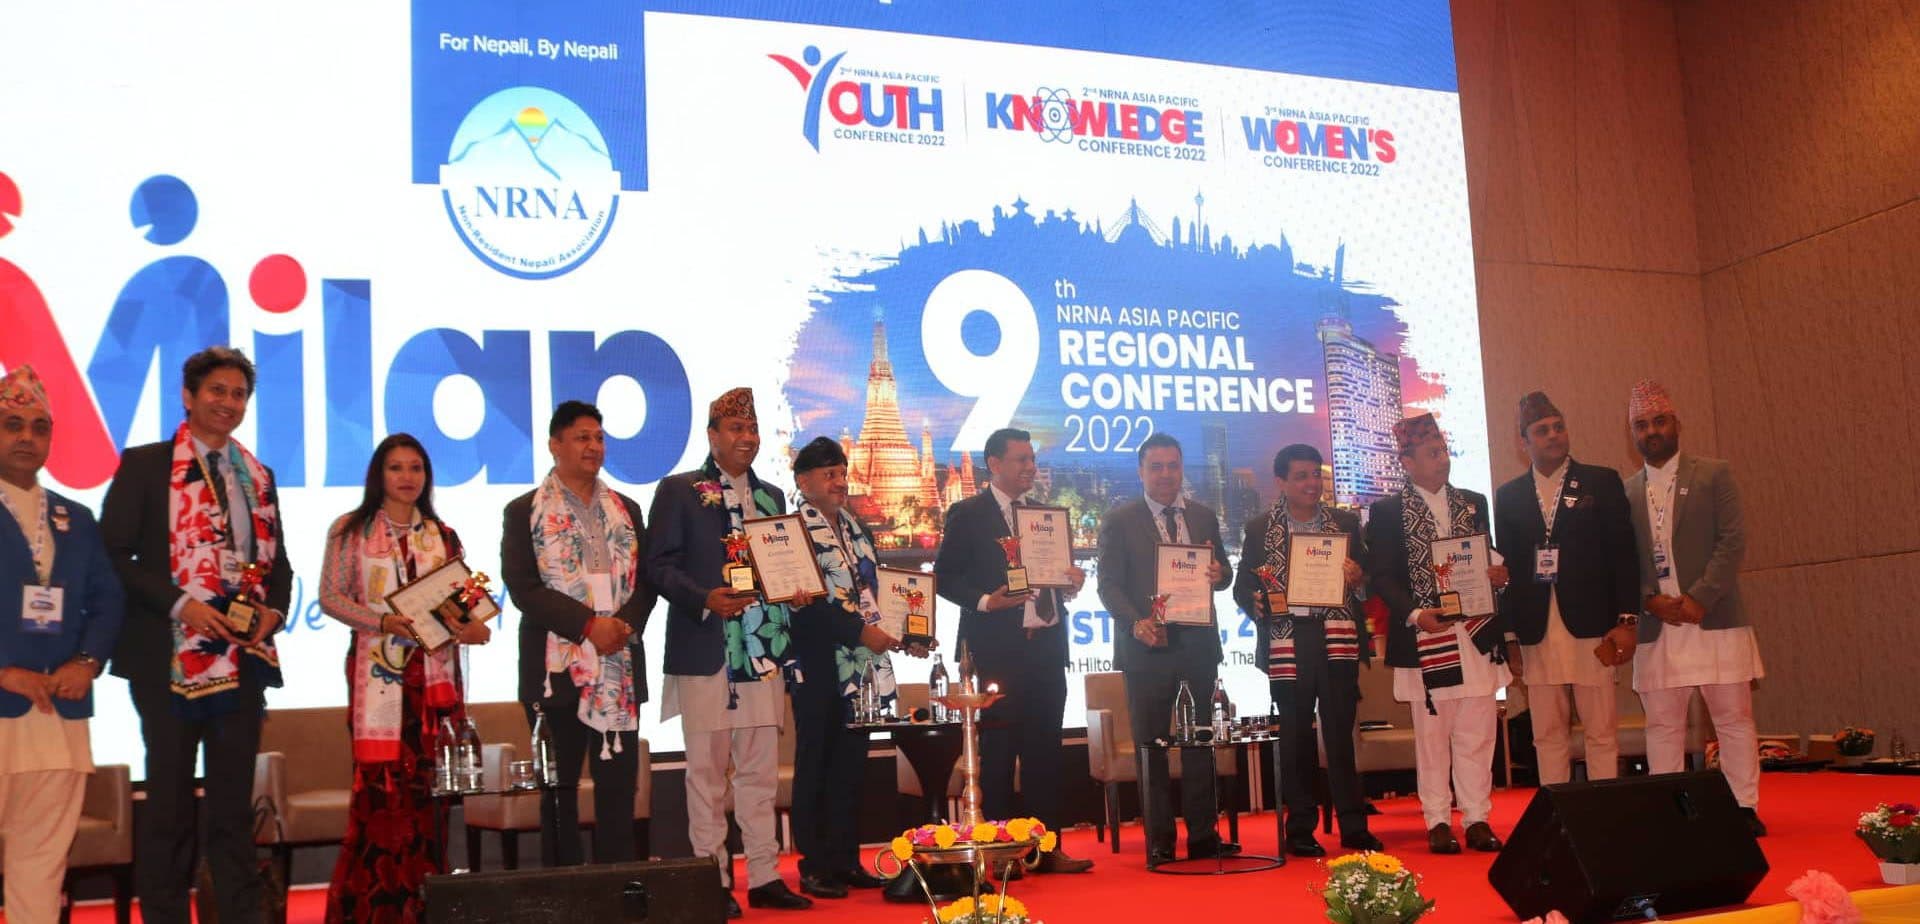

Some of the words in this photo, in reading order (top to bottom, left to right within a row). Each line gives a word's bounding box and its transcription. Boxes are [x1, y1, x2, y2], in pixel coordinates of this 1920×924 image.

[440, 33, 469, 50] For
[473, 35, 534, 56] Nepali,
[538, 39, 560, 60] By
[564, 40, 618, 61] Nepali
[854, 69, 880, 78] NRNA
[882, 72, 902, 80] ASIA
[905, 73, 940, 83] PACIFIC
[1099, 89, 1129, 101] NRNA
[1132, 92, 1156, 104] ASIA
[1158, 94, 1199, 108] PACIFIC
[986, 89, 1205, 146] KNOWLEDGE
[1278, 107, 1306, 119] NRNA
[1309, 111, 1331, 121] ASIA
[1333, 113, 1370, 126] PACIFIC
[834, 128, 913, 144] CONFERENCE
[917, 134, 945, 147] 2022
[1078, 139, 1171, 159] CONFERENCE
[1174, 147, 1206, 162] 2022
[1240, 116, 1396, 164] WOMEN'S
[1264, 155, 1347, 174] CONFERENCE
[1350, 163, 1380, 177] 2022
[474, 185, 589, 220] NRNA
[459, 205, 516, 264] Non-Resident
[520, 258, 555, 268] Nepali
[559, 211, 604, 262] Association
[1054, 278, 1076, 299] th
[1056, 306, 1112, 325] NRNA
[1118, 307, 1161, 327] ASIA
[1168, 309, 1240, 330] PACIFIC
[921, 269, 1040, 452] 9
[1058, 329, 1254, 371] REGIONAL
[1061, 372, 1315, 413] CONFERENCE
[1064, 415, 1154, 452] 2022
[1079, 657, 1112, 672] Hilto
